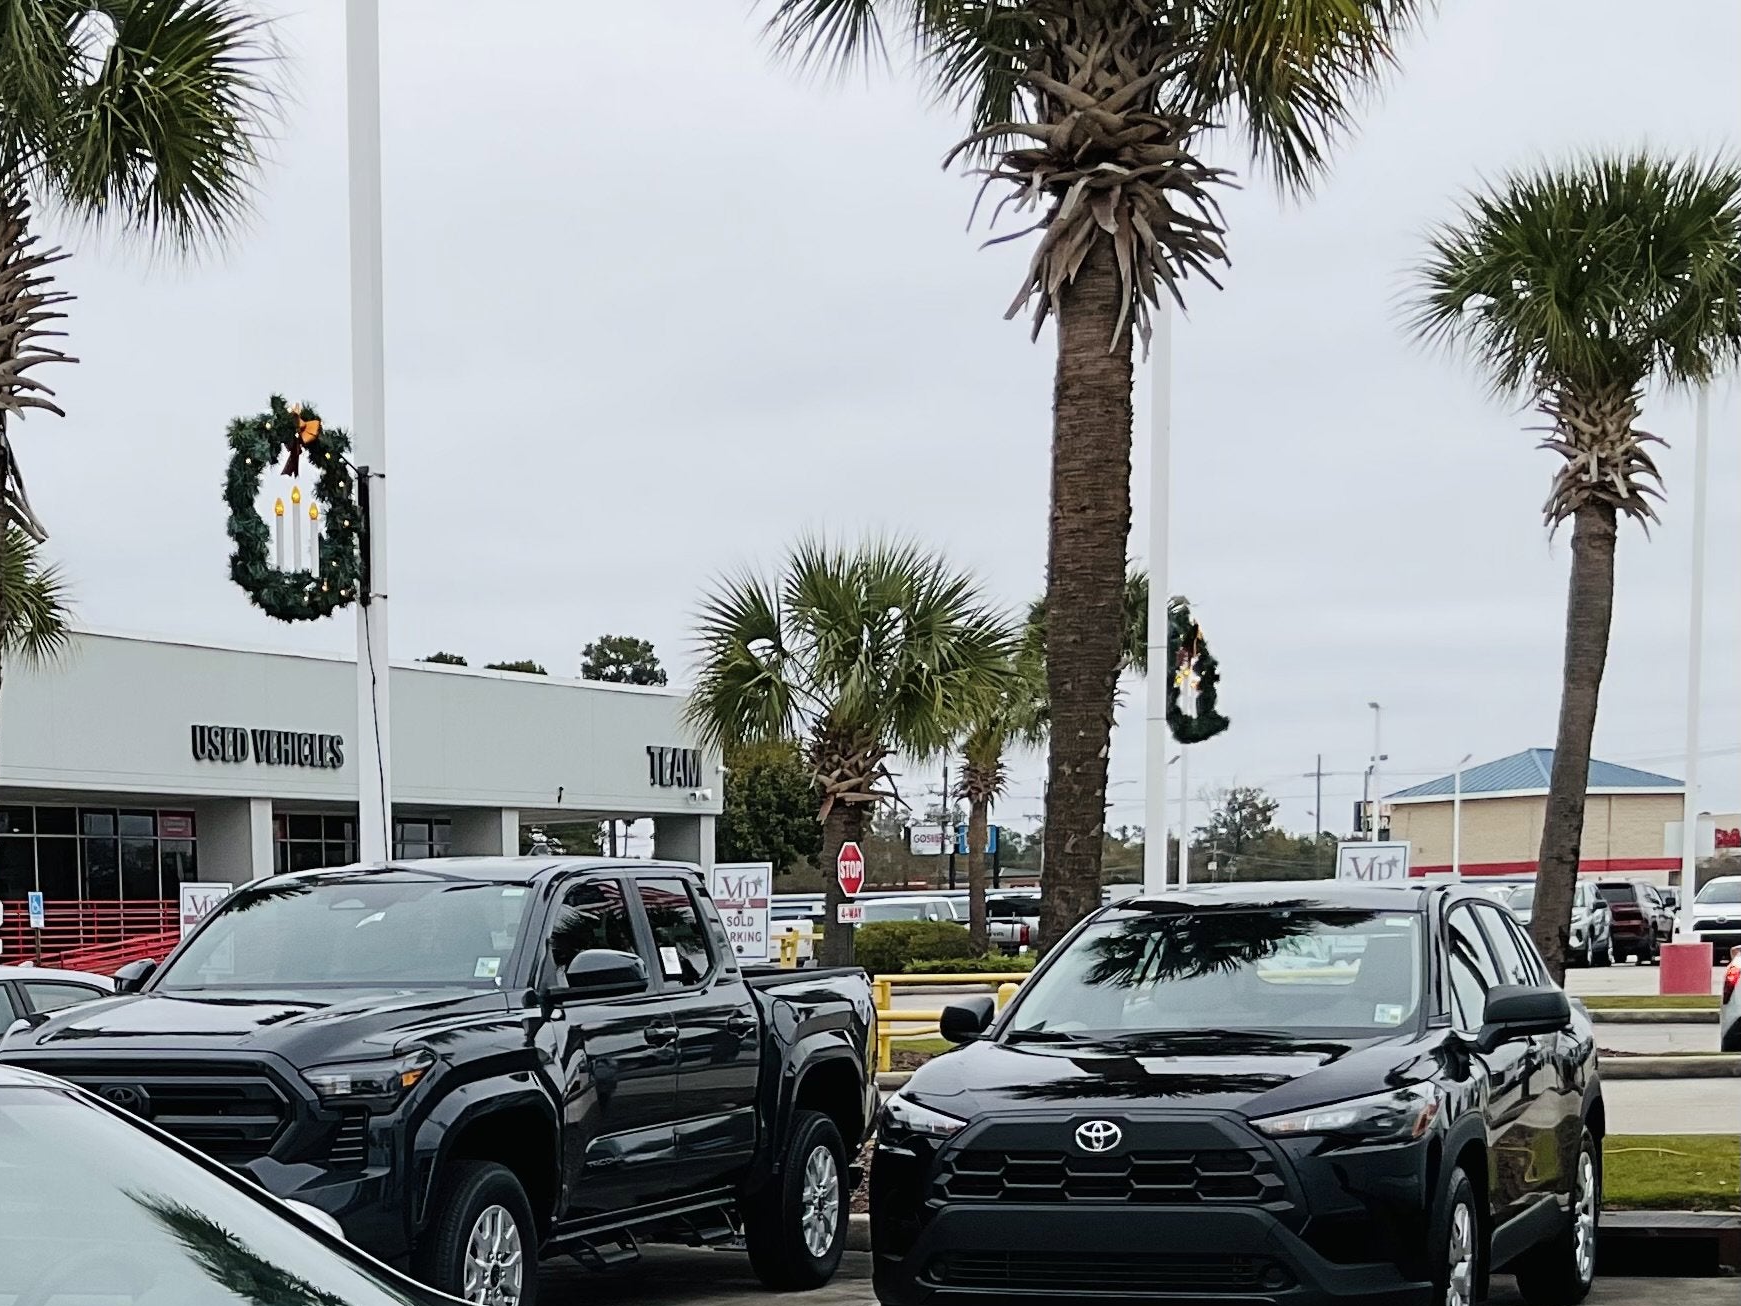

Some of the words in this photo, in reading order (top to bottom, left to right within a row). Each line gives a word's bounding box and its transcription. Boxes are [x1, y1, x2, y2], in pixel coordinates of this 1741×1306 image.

[191, 725, 249, 761] USED
[251, 729, 344, 768] VEHICLES
[646, 746, 702, 787] TEAM
[840, 860, 861, 879] STOP
[841, 906, 862, 919] 4-WAY
[726, 916, 754, 927] SOLD
[729, 931, 762, 942] RKING
